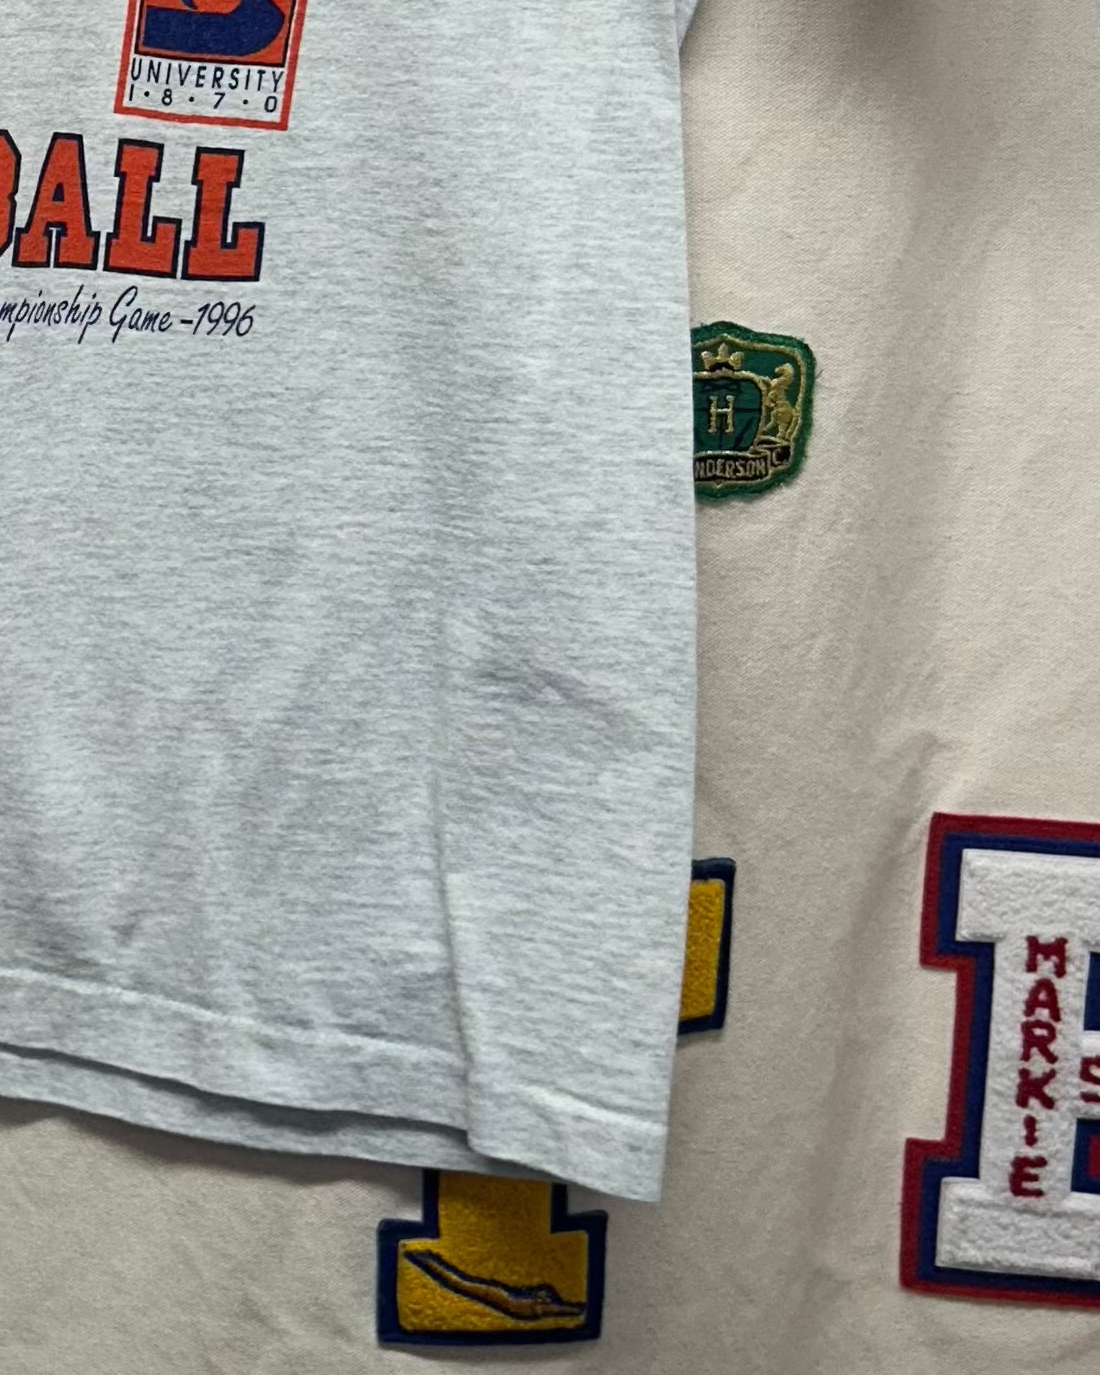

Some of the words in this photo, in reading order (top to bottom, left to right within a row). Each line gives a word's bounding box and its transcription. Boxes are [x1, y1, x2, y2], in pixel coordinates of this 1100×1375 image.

[130, 57, 285, 93] UNIVERSITY
[109, 285, 173, 343] Game
[707, 394, 736, 434] H
[695, 459, 768, 478] NDERSON
[1009, 935, 1070, 1199] MARKIE
